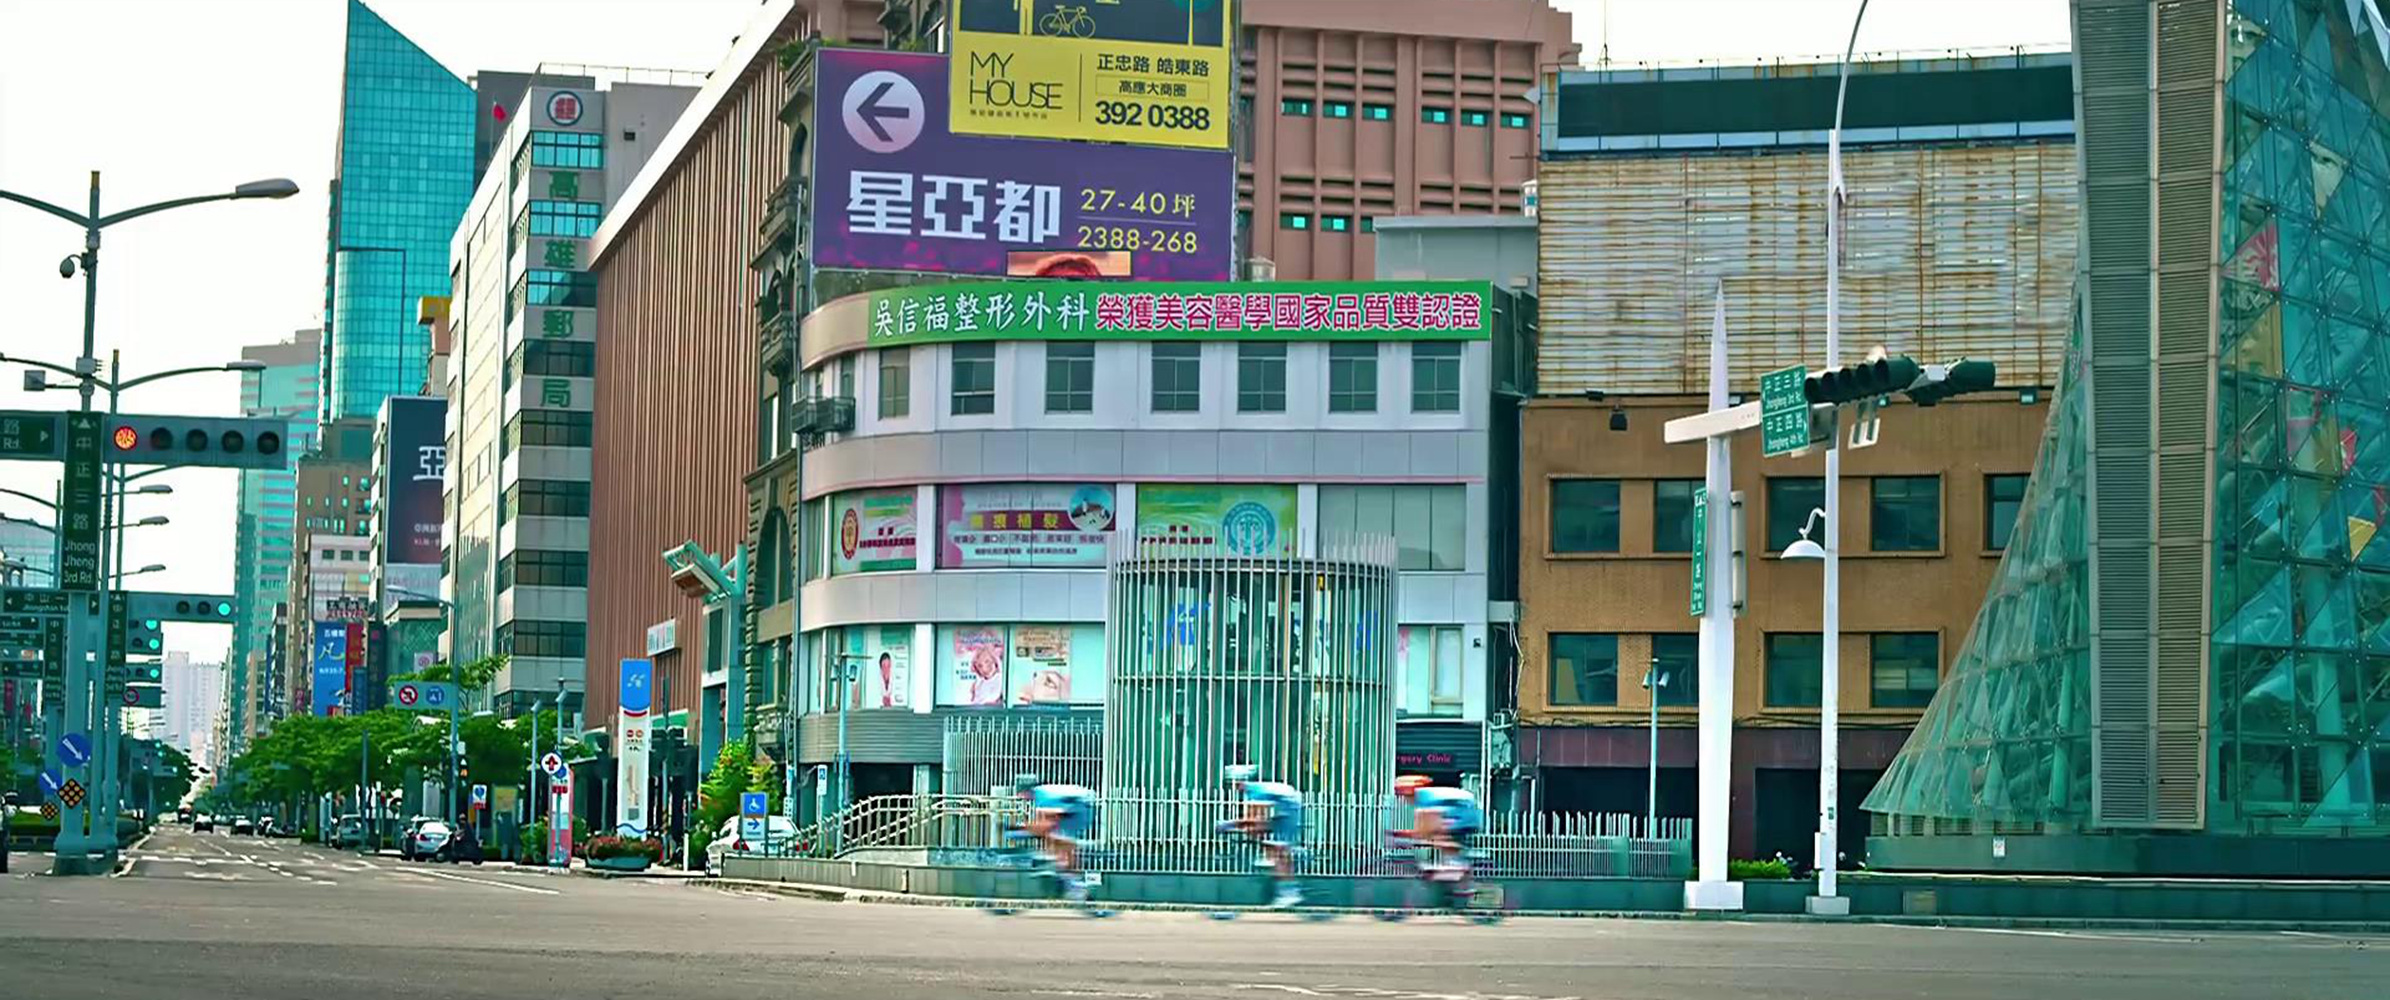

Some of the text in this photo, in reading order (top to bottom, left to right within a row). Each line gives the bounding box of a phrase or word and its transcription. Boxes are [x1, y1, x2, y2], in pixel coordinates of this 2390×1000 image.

[970, 50, 1014, 77] MY
[1097, 53, 1210, 77] 正忠路 皓東路
[970, 80, 1063, 109] HOUSE
[1119, 80, 1187, 97] 高應大商圈
[1095, 101, 1210, 130] 392 0388
[846, 170, 1061, 244] 星亞都
[1081, 189, 1196, 219] 27-40 坪
[1077, 226, 1197, 253] 2388-268
[540, 171, 580, 408] 高雄郵局
[874, 291, 1482, 338] 吳信福整形外科 榮獲美容醫學國家品質雙認證
[64, 540, 96, 555] Jhong
[64, 570, 78, 583] 3rd
